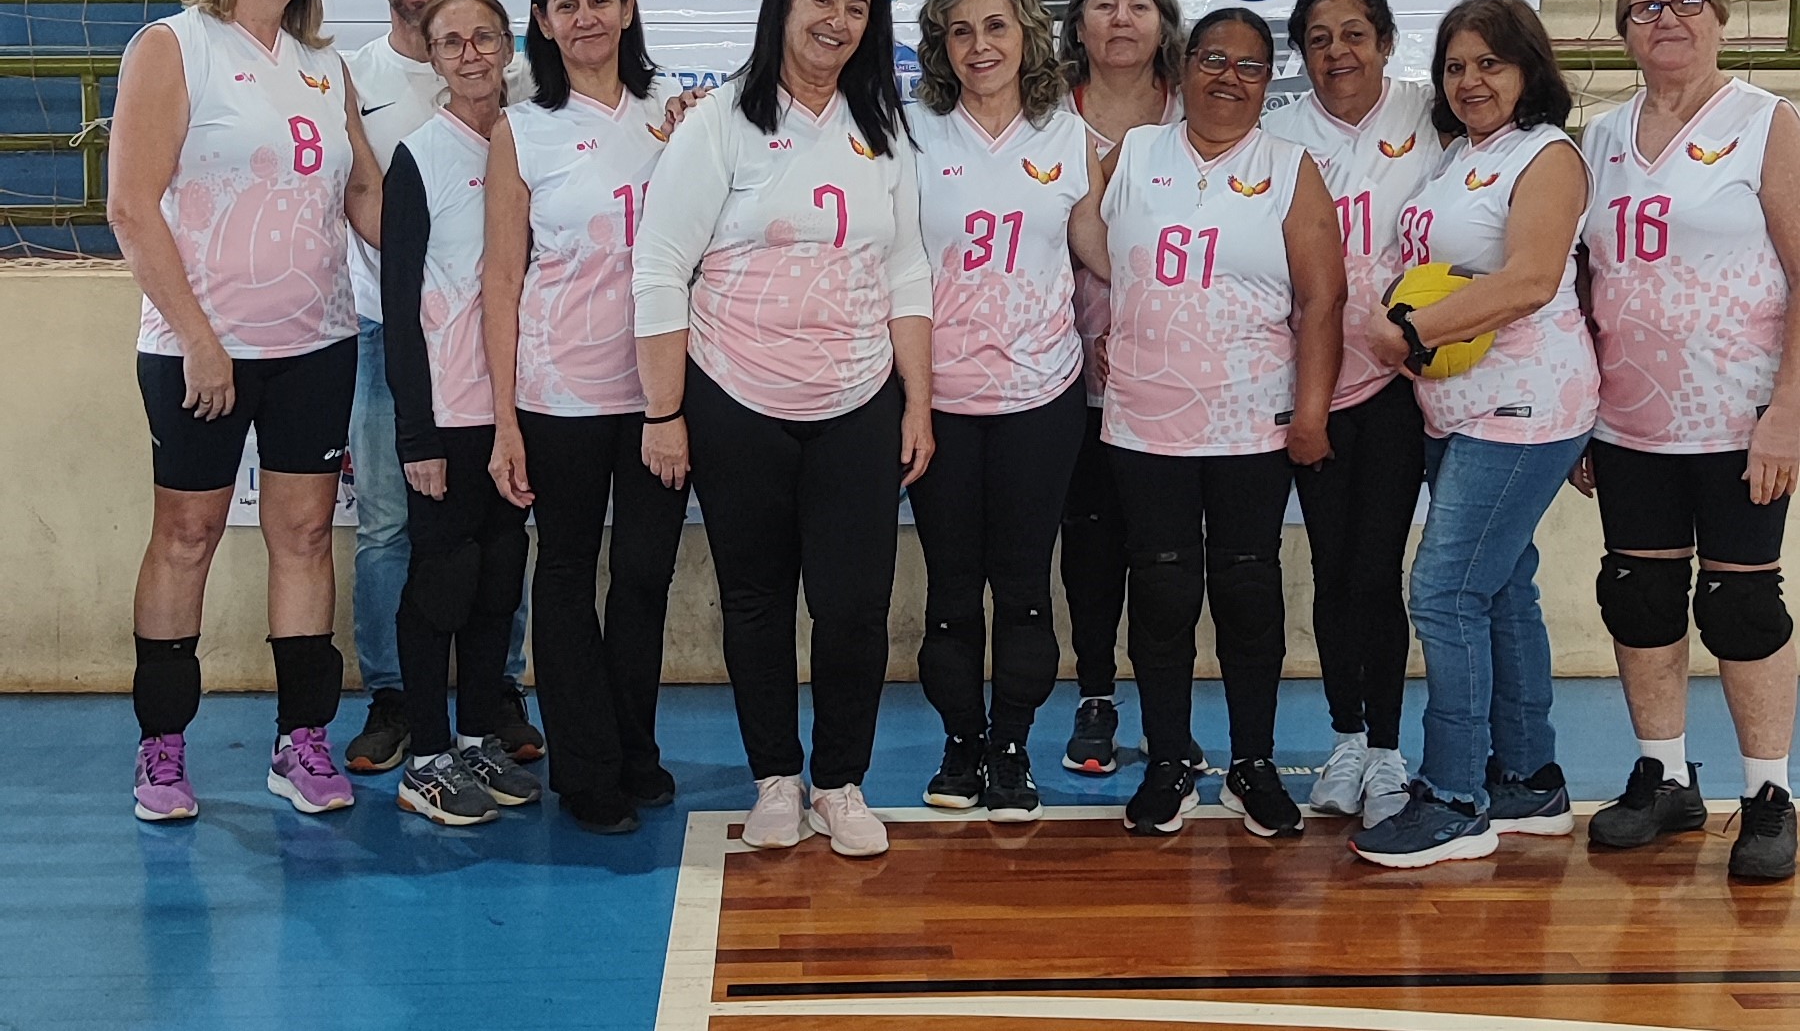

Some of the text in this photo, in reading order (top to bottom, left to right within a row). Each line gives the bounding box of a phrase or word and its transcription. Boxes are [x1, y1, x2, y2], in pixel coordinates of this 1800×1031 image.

[288, 115, 323, 176] 8
[814, 184, 847, 248] 7
[963, 209, 1023, 274] 31
[1400, 205, 1434, 265] 33
[1607, 194, 1671, 263] 16
[1155, 224, 1218, 289] 61
